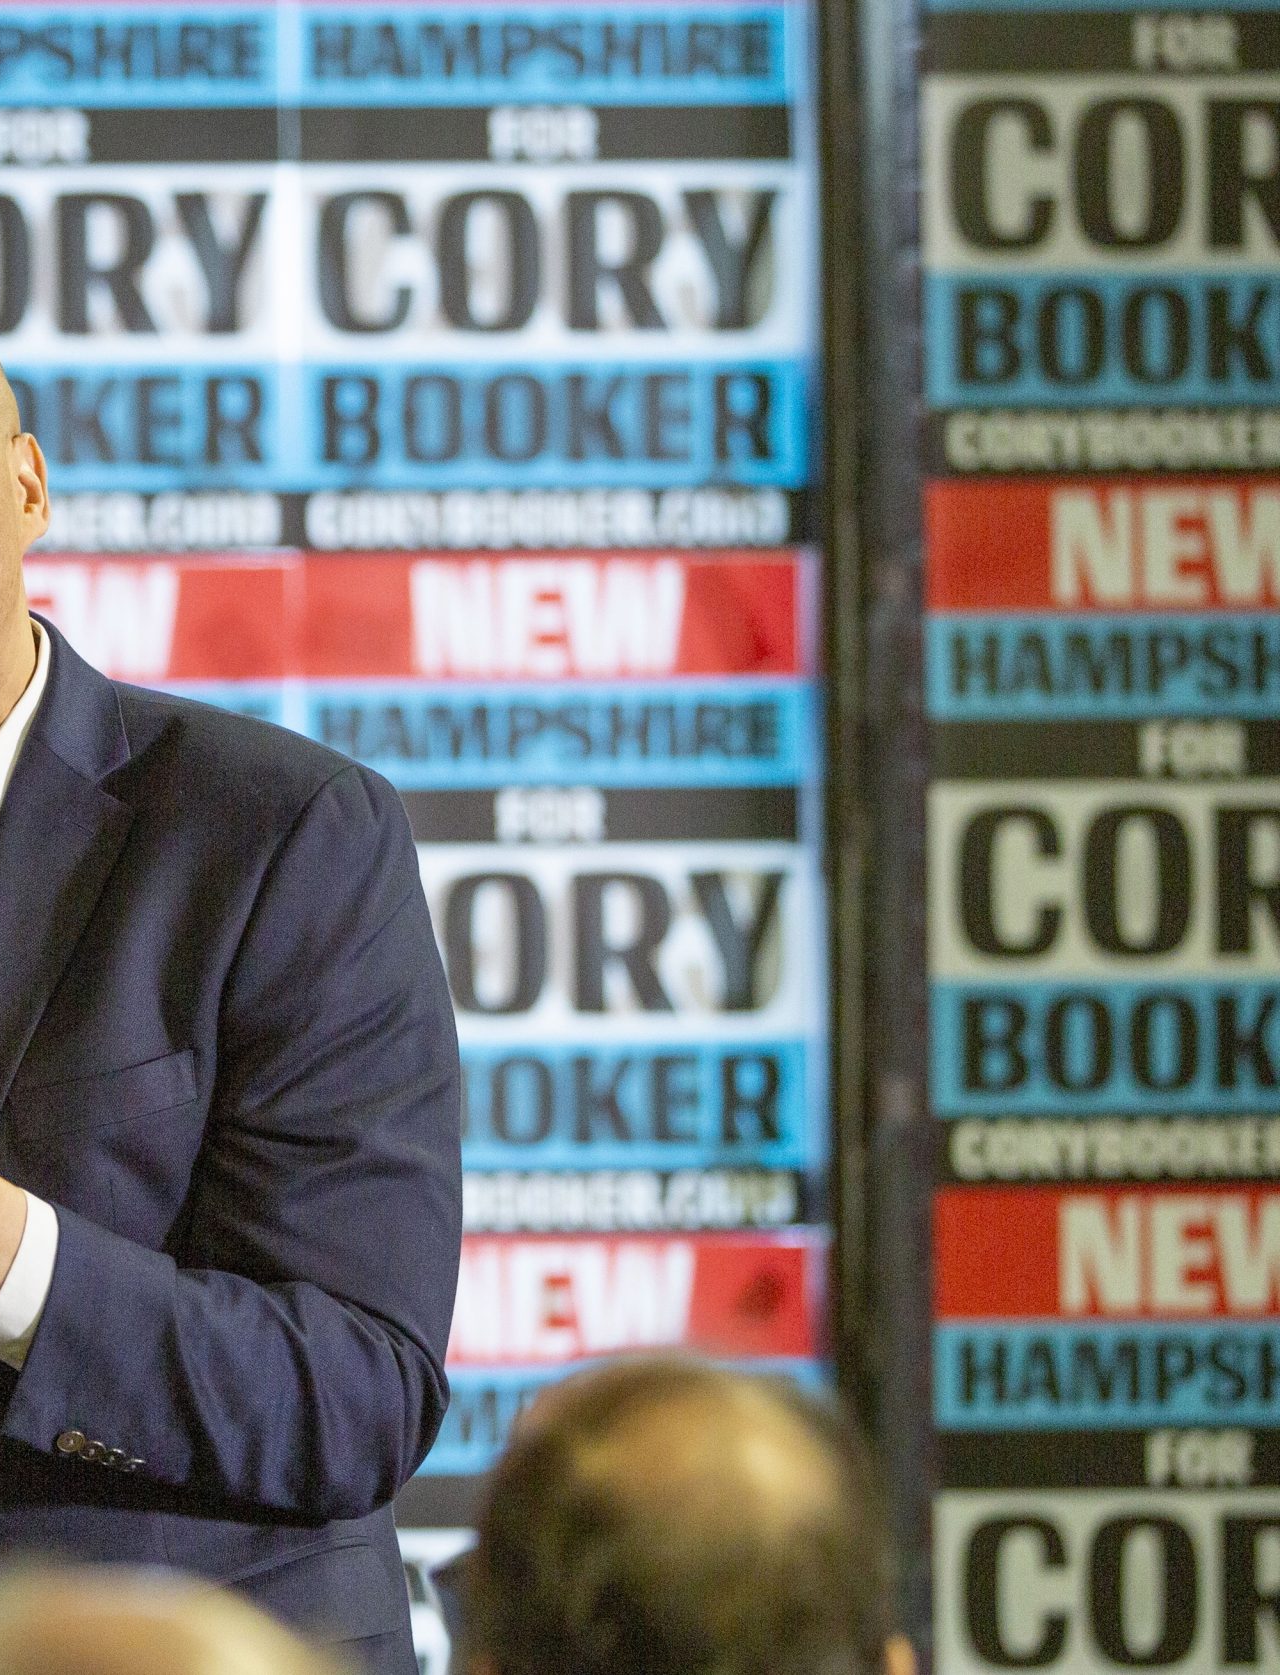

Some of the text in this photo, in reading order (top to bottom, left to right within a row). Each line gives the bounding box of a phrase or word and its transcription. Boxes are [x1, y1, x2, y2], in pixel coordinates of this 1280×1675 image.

[312, 21, 771, 80] HAMPSHIRE
[1131, 14, 1236, 69] FOR
[487, 106, 599, 161] FOR
[949, 95, 1280, 255] COR
[317, 189, 780, 335] CORY
[956, 285, 1274, 387] BOOK
[6, 374, 264, 465] KER
[322, 373, 771, 464] BOOKER
[410, 558, 686, 676] NEW
[321, 702, 779, 762] HAMPSHIRE
[1139, 722, 1246, 774] FOR
[495, 786, 607, 841] FOR
[956, 805, 1280, 960] COR
[442, 870, 787, 1015] ORY
[961, 995, 1276, 1092] BOOK
[461, 1055, 780, 1145] OKER
[1145, 1432, 1254, 1484] FOR
[963, 1514, 1280, 1669] COR
